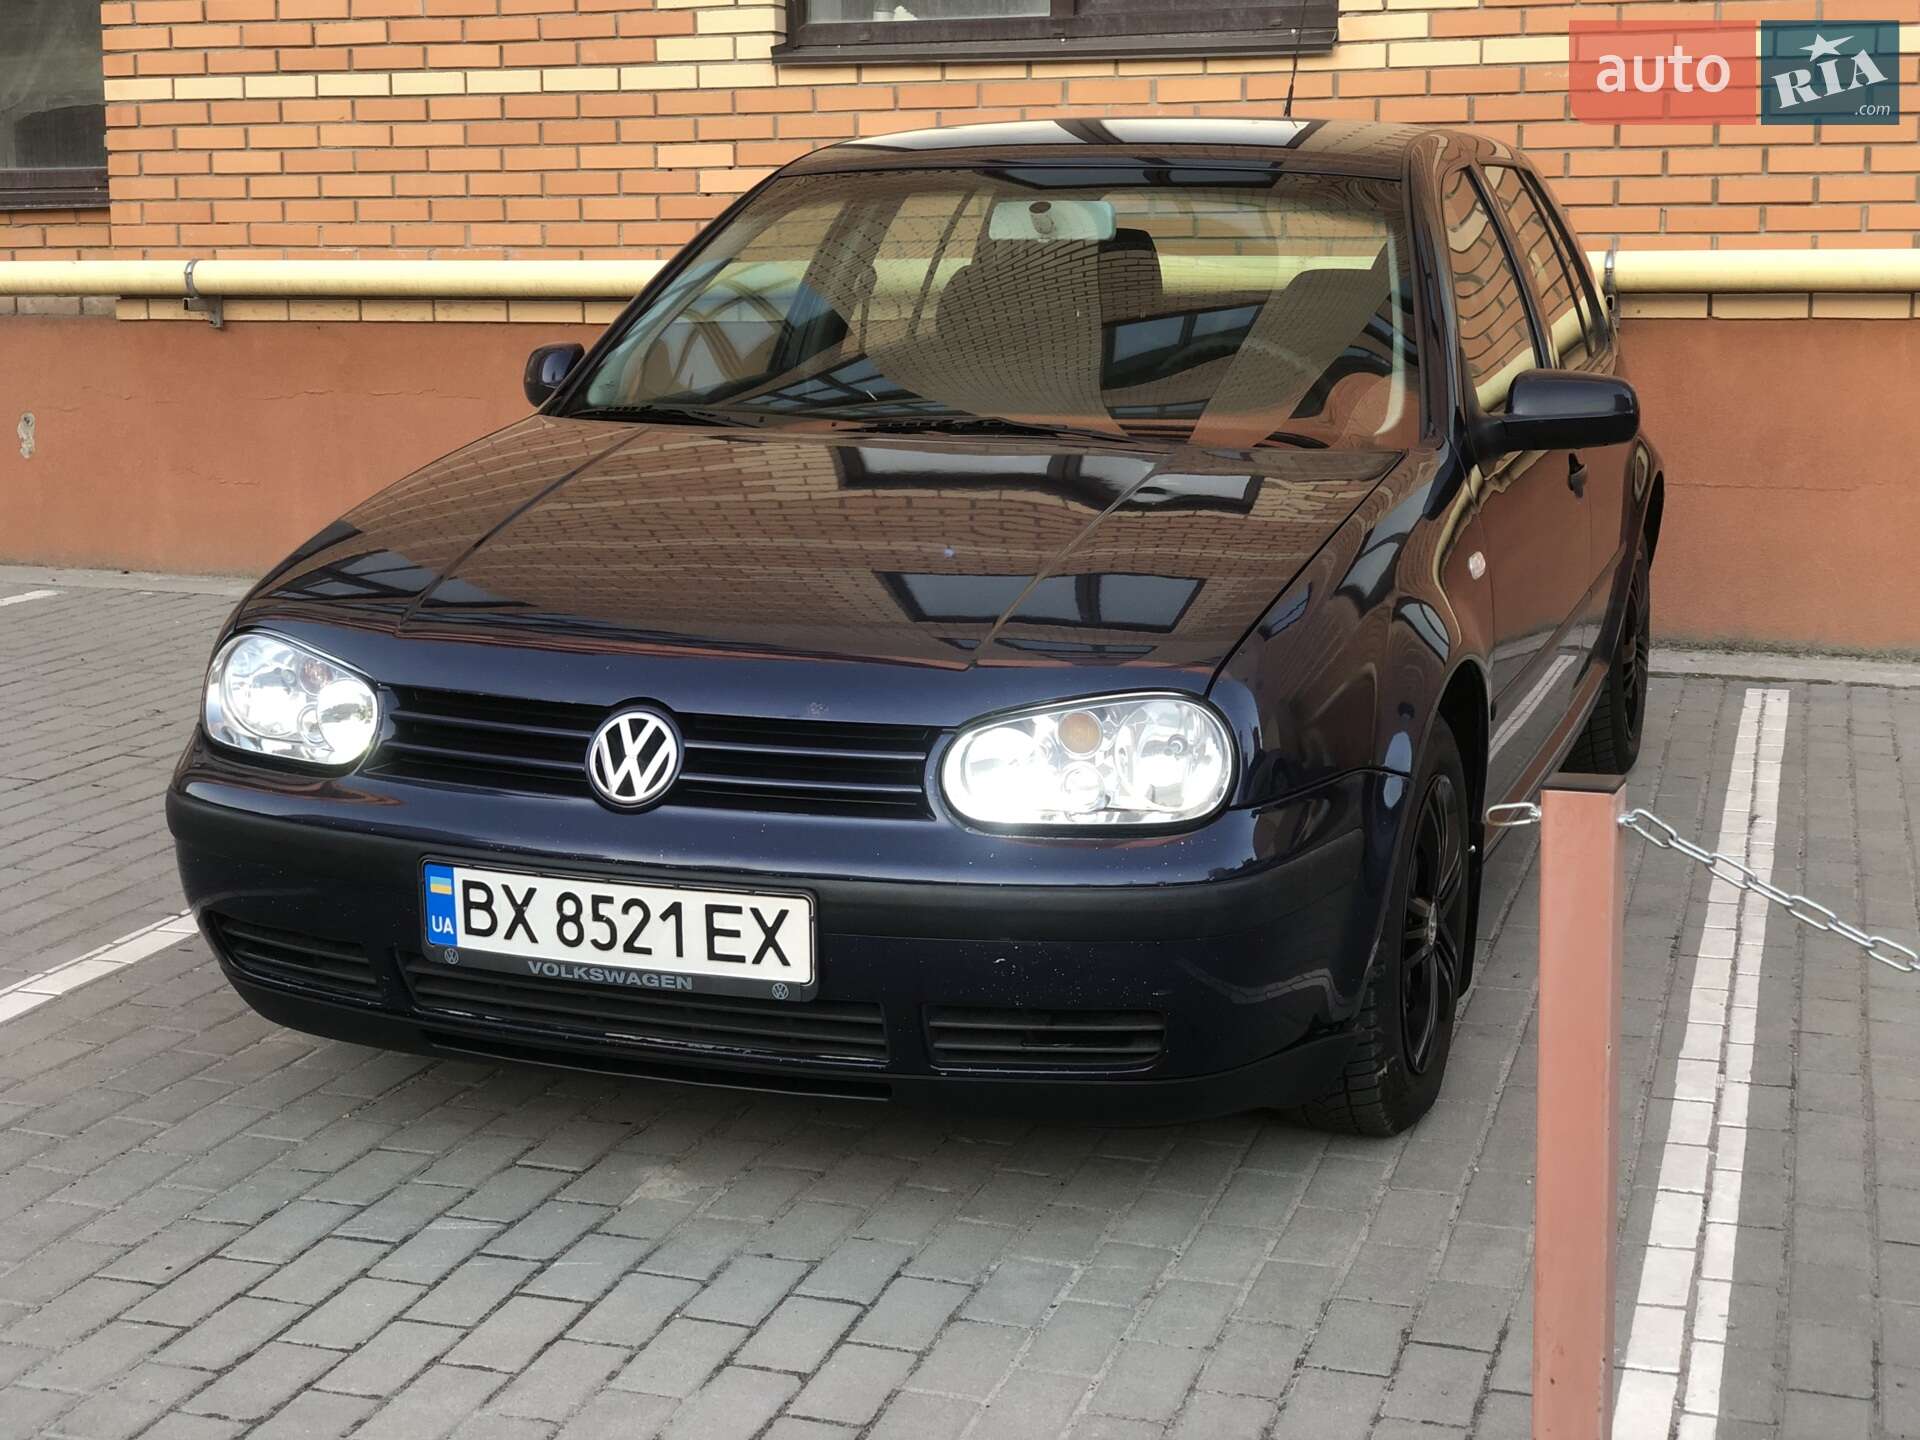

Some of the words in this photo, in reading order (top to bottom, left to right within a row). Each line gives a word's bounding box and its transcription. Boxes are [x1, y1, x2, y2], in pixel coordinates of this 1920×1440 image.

[589, 711, 678, 803] VW
[432, 915, 454, 935] UA
[462, 879, 538, 944] BX
[556, 892, 684, 958] 8521
[705, 903, 791, 967] EX
[528, 960, 692, 990] VOLKSWAGEN
